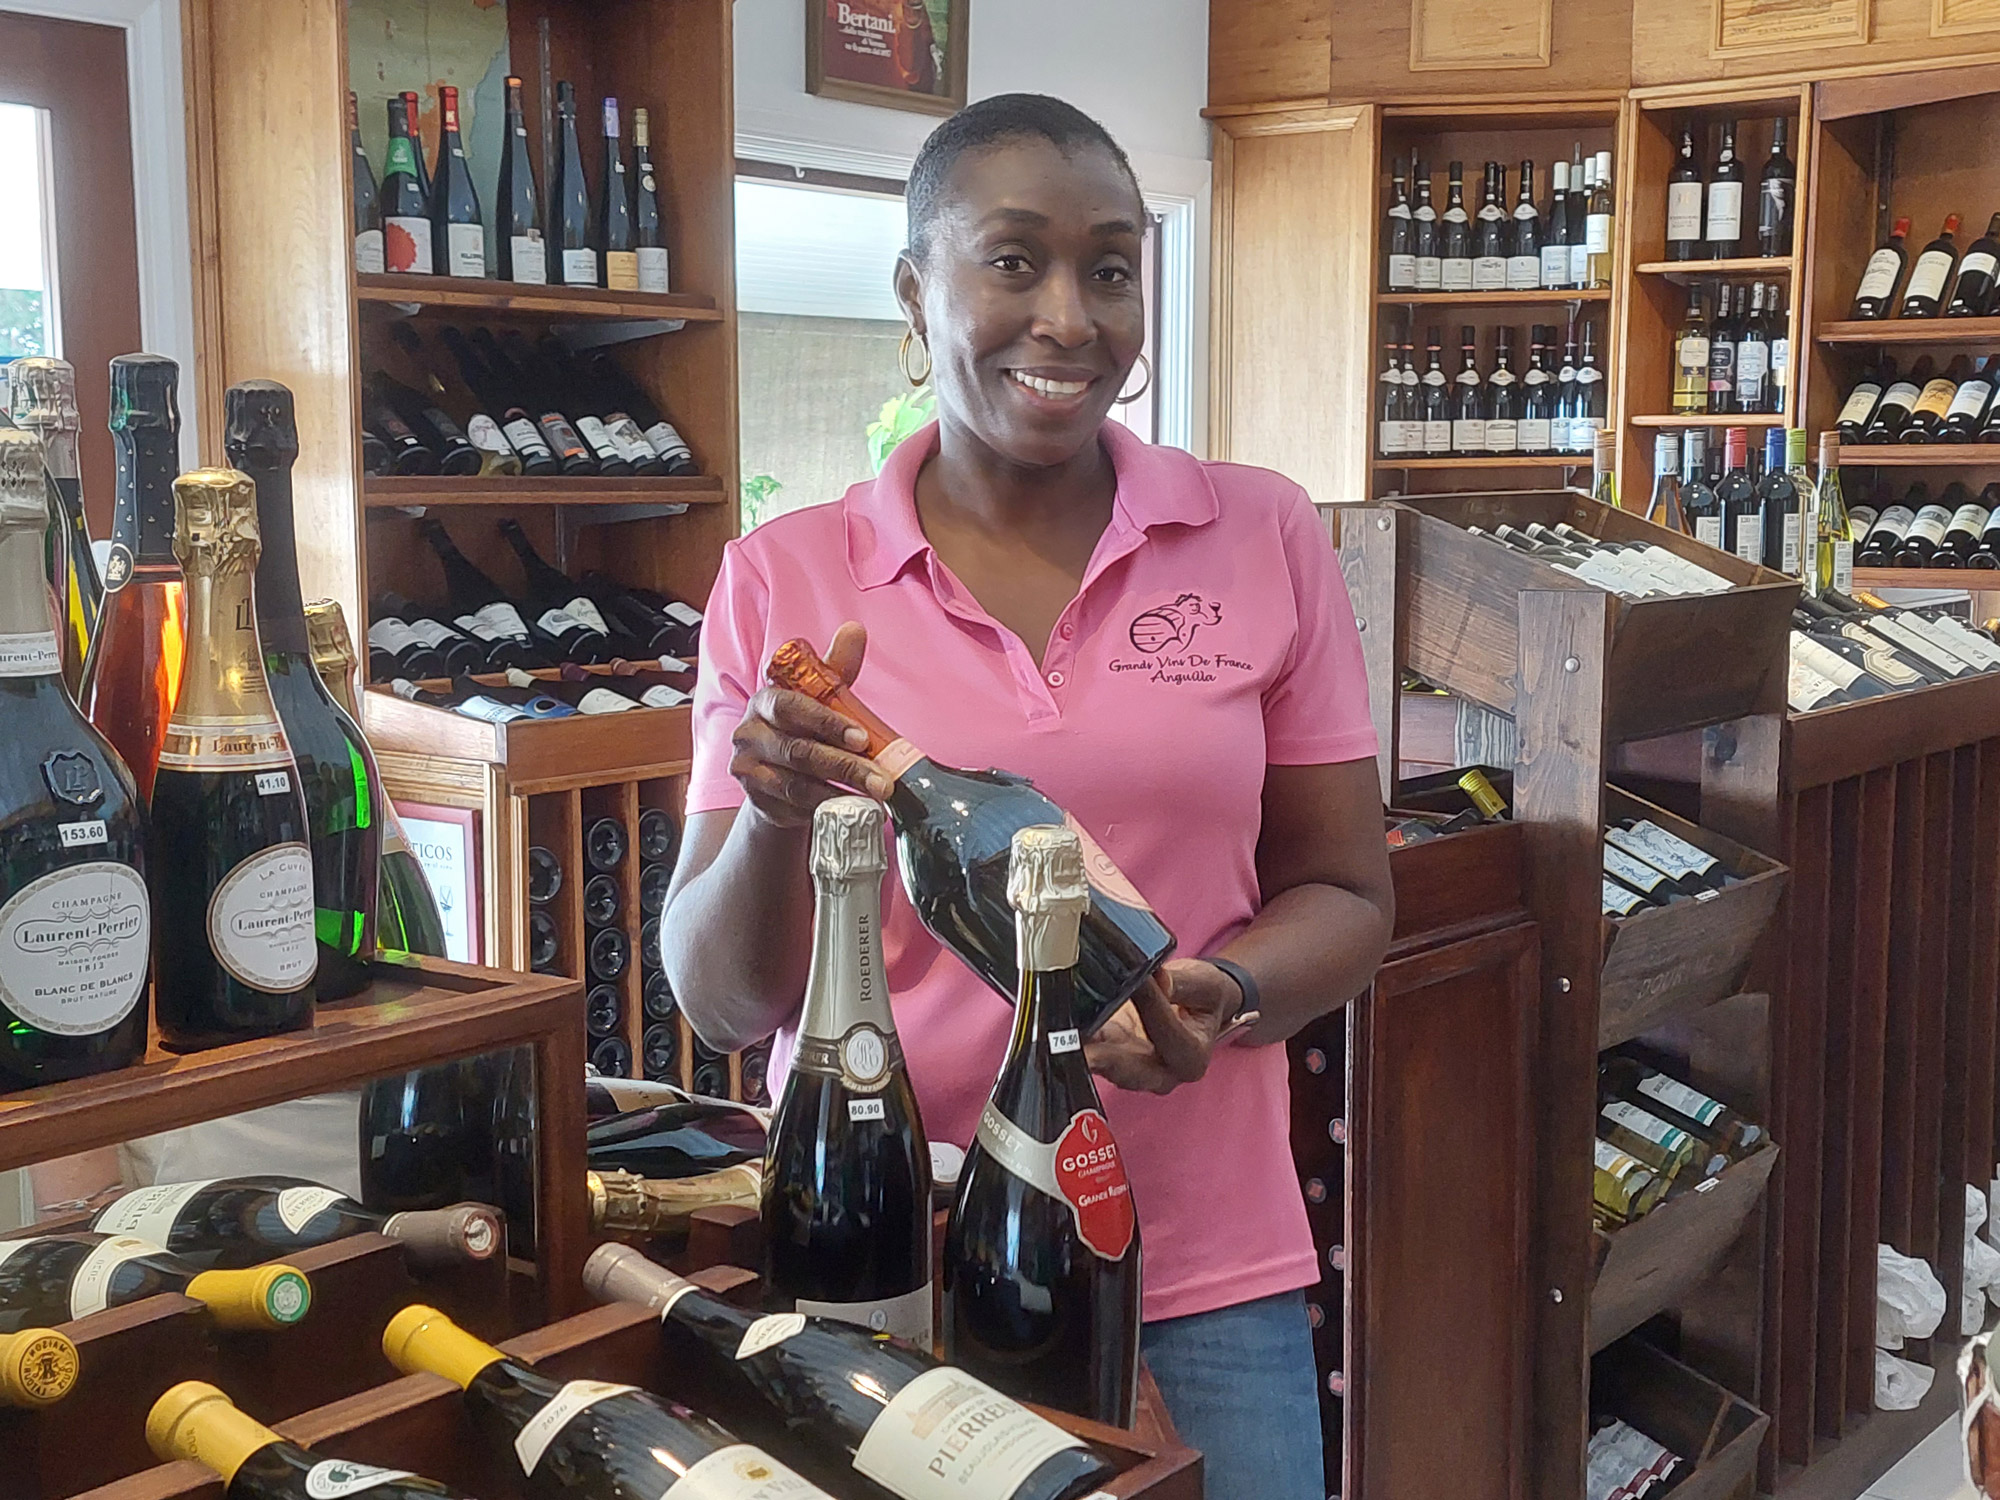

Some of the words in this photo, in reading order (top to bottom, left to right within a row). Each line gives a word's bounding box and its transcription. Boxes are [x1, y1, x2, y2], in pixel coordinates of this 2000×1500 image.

[1109, 659, 1153, 673] Grands
[1156, 655, 1186, 668] Vins
[1187, 654, 1212, 667] De
[1214, 653, 1254, 671] France
[1150, 669, 1217, 685] Anguilla
[258, 777, 286, 790] 41.10
[61, 825, 104, 842] 153.60
[51, 892, 122, 910] CHAMPAGNE
[23, 915, 139, 944] Laurent-Perrier
[858, 913, 873, 1003] ROEDERER
[34, 985, 76, 997] BLANC
[80, 982, 96, 991] DE
[99, 971, 134, 988] BLANCS
[61, 995, 85, 1005] BRUT
[88, 988, 118, 1000] NATURE
[1052, 1034, 1079, 1048] 76.50
[851, 1103, 880, 1116] 80.90
[983, 1111, 1024, 1153] GOSSET
[1062, 1143, 1117, 1172] GOSSET
